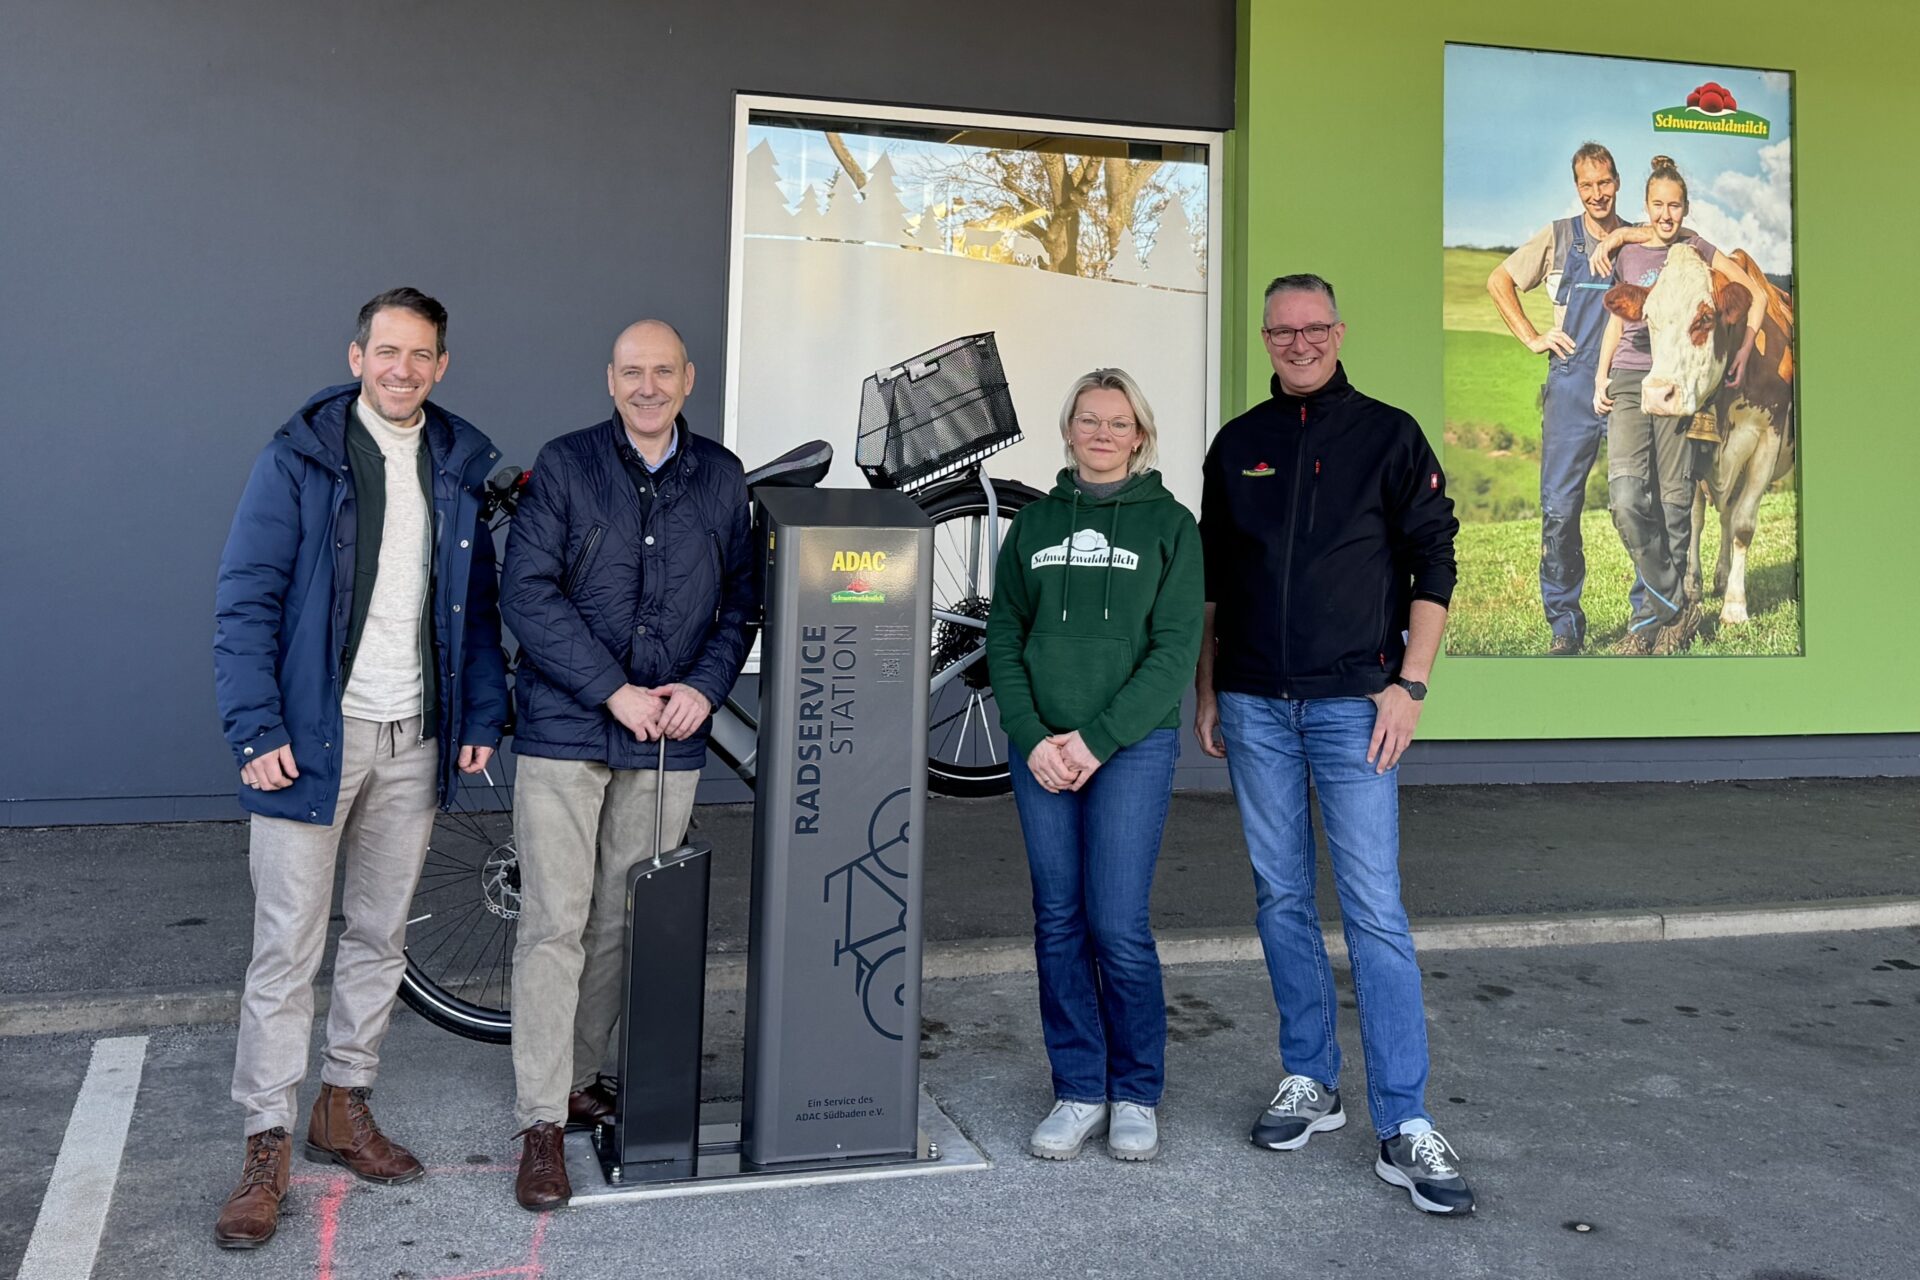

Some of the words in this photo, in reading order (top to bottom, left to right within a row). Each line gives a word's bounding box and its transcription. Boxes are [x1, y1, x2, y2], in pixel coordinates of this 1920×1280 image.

[1655, 114, 1767, 135] Schwarzwaldmilch
[831, 551, 886, 572] ADAC
[1032, 552, 1135, 566] Schwazwaldmilch
[830, 625, 857, 754] STATION
[795, 626, 827, 834] RADSERVICE
[807, 1099, 821, 1108] Ein
[824, 1096, 856, 1107] Service
[858, 1095, 874, 1104] des
[795, 1112, 821, 1121] ADAC
[823, 1109, 866, 1120] Südbaden
[869, 1108, 885, 1117] e.V.
